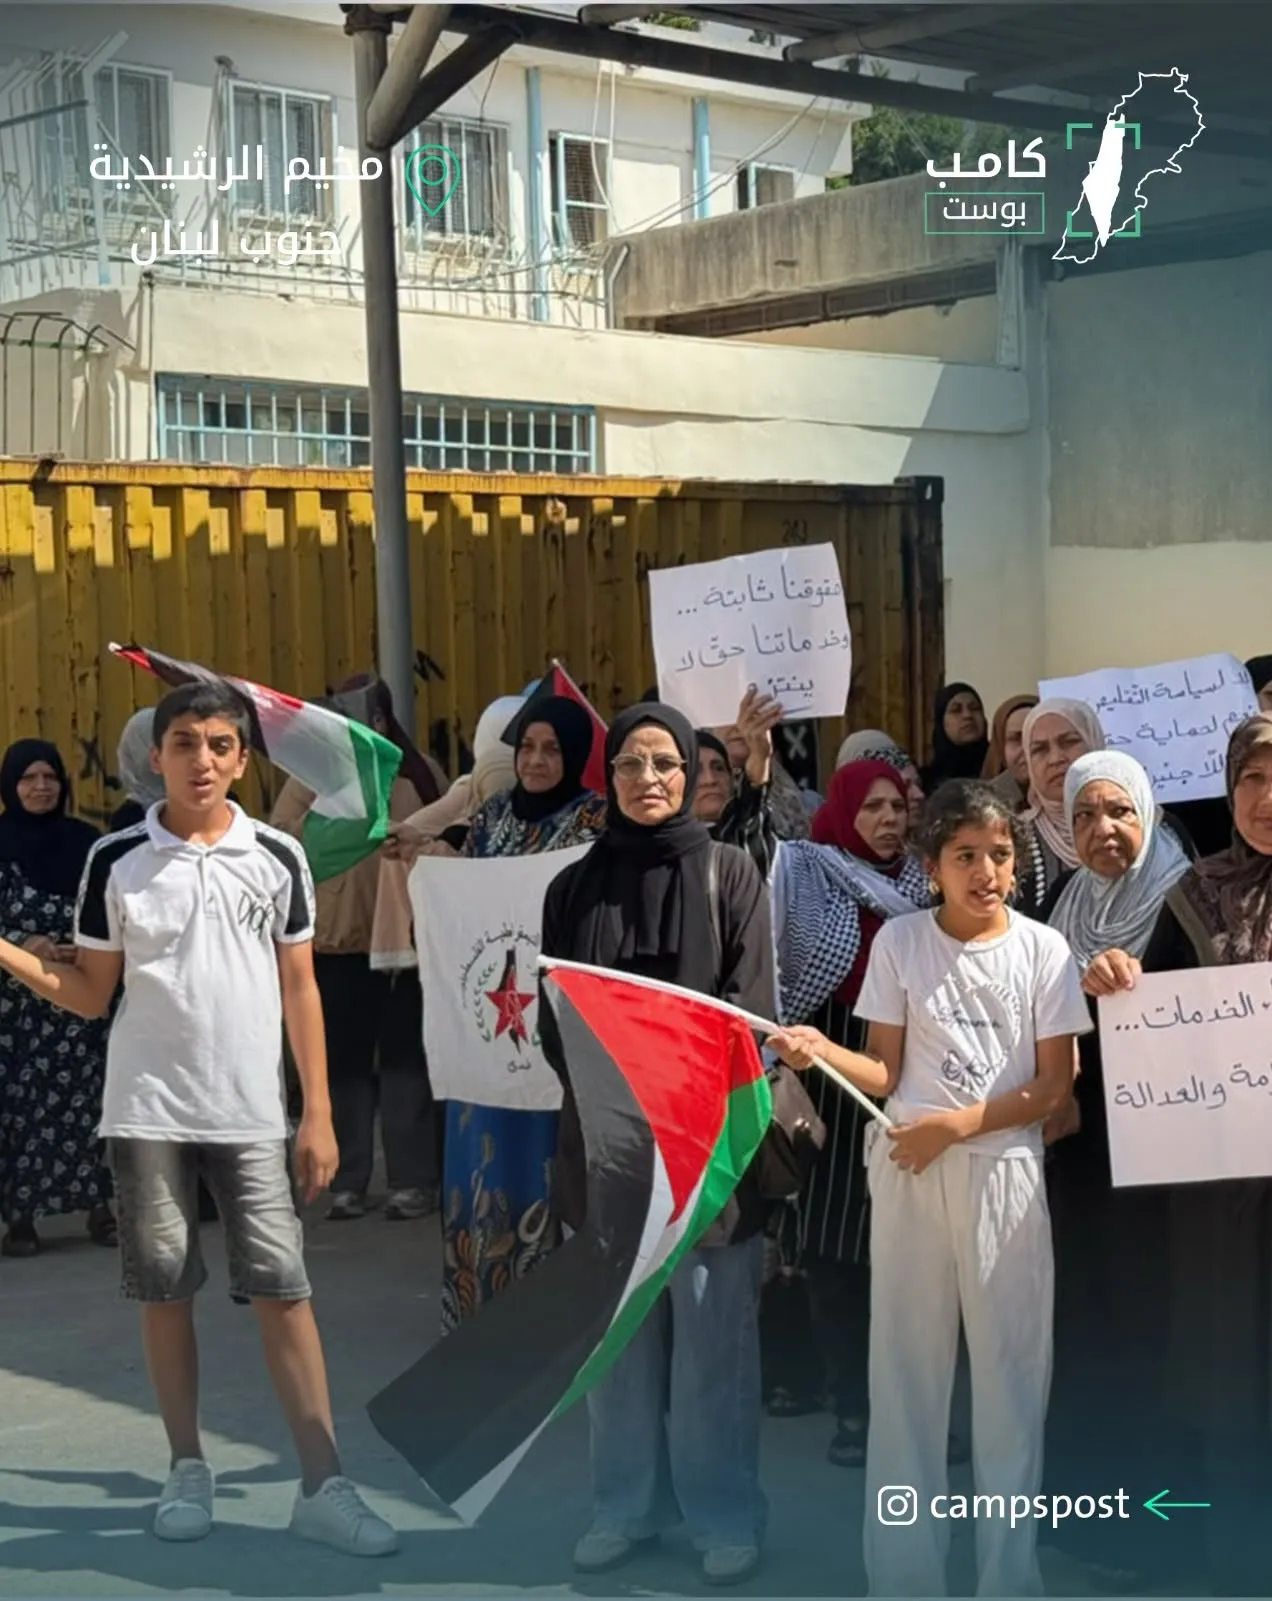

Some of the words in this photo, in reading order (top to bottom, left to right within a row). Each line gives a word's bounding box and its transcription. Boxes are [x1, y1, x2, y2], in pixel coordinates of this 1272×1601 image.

[675, 650, 695, 673] لا
[767, 675, 815, 699] ينتز
[1152, 669, 1225, 700] لسياسة
[1136, 714, 1218, 746] لحماية
[1114, 1075, 1227, 1111] والعدالة
